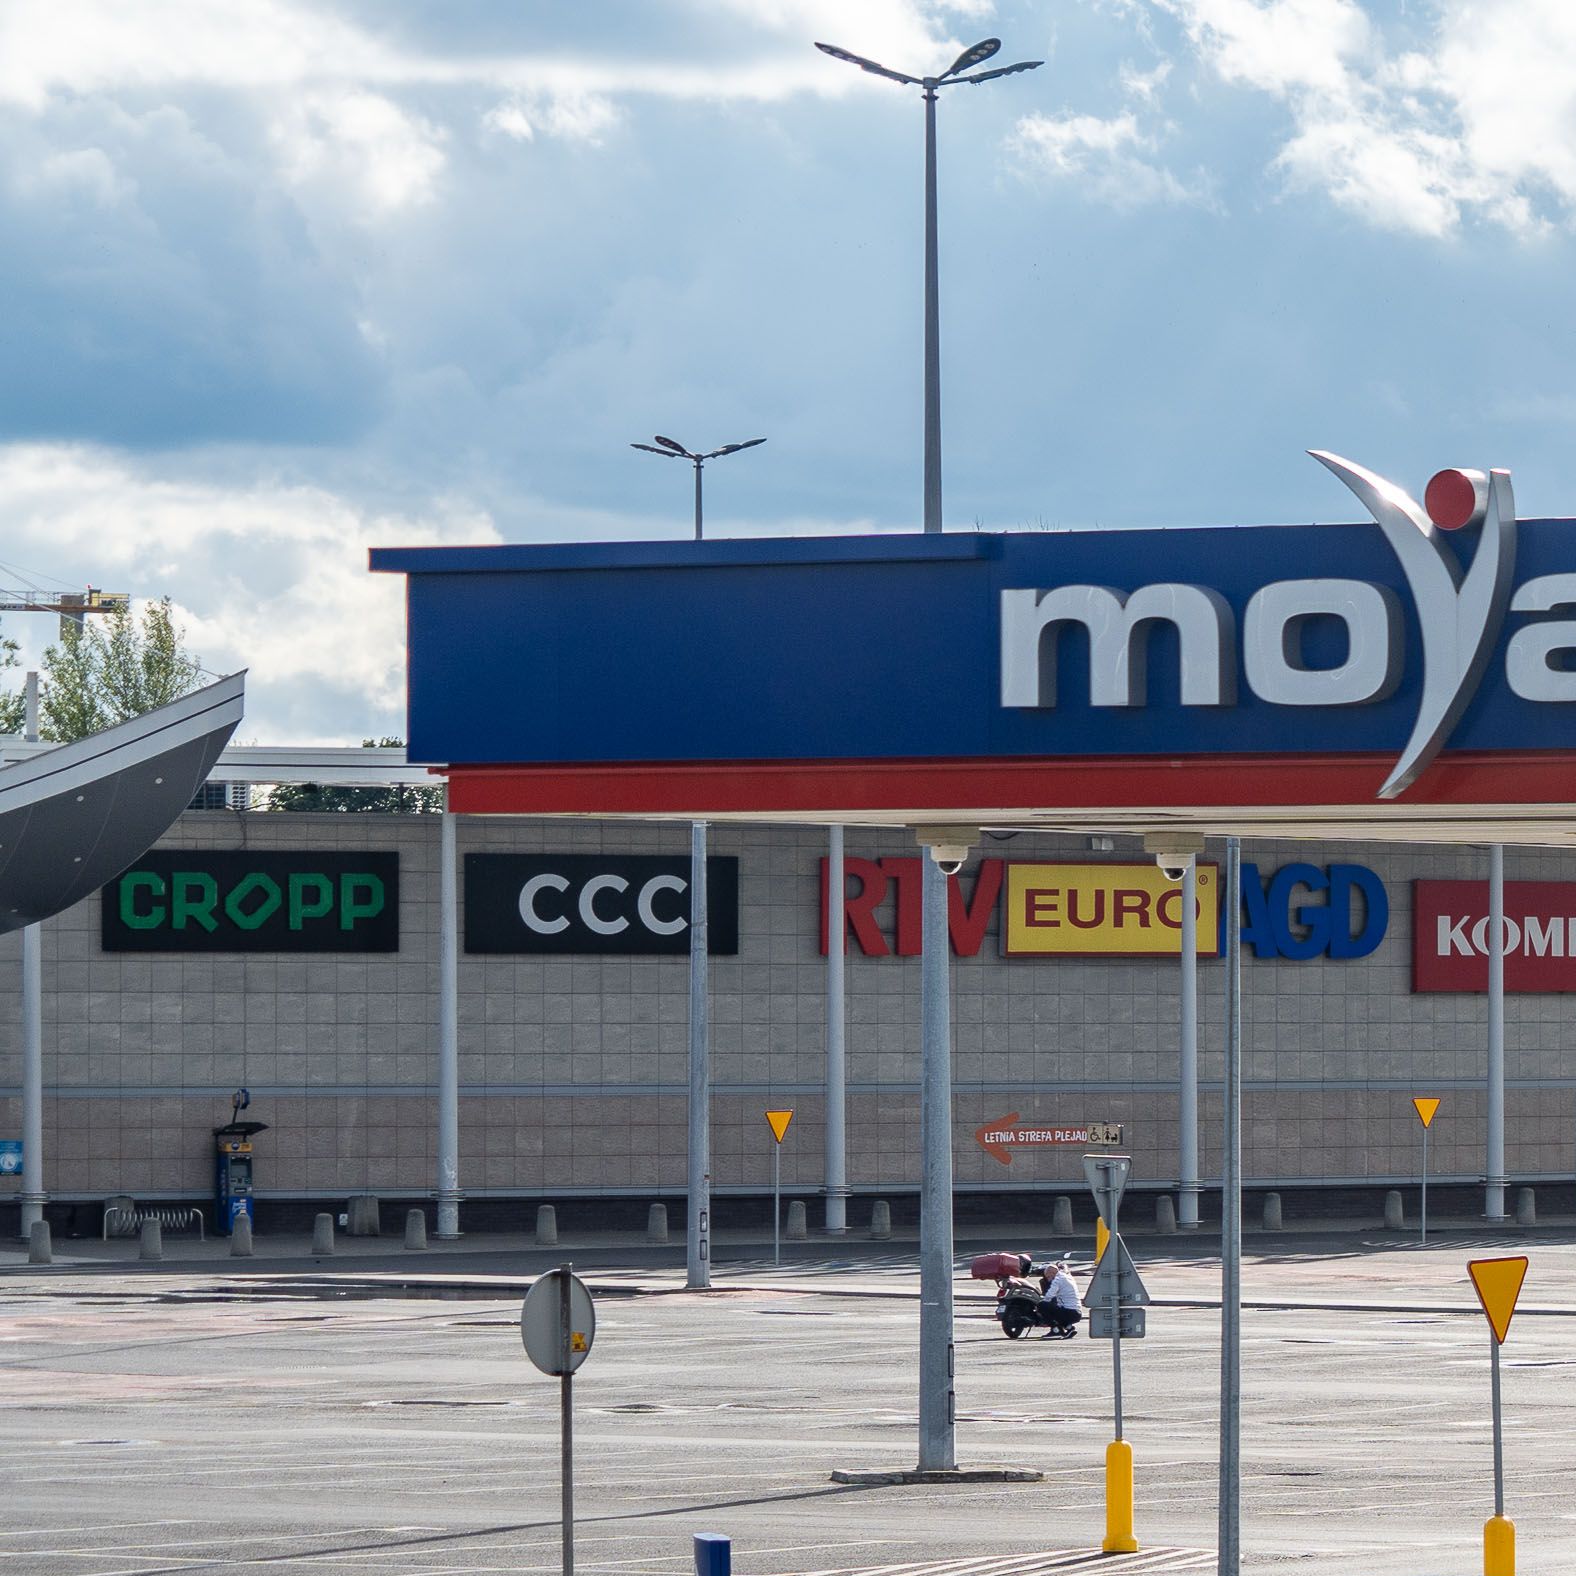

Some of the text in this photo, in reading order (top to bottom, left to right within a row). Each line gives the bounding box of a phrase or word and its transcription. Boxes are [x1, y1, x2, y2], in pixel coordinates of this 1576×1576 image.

[119, 871, 386, 931] CROPP
[518, 874, 689, 934] CCC
[819, 856, 1388, 960] RTV EURO AGD
[985, 1131, 1016, 1143] LETNIA
[1018, 1130, 1052, 1142] STREFA
